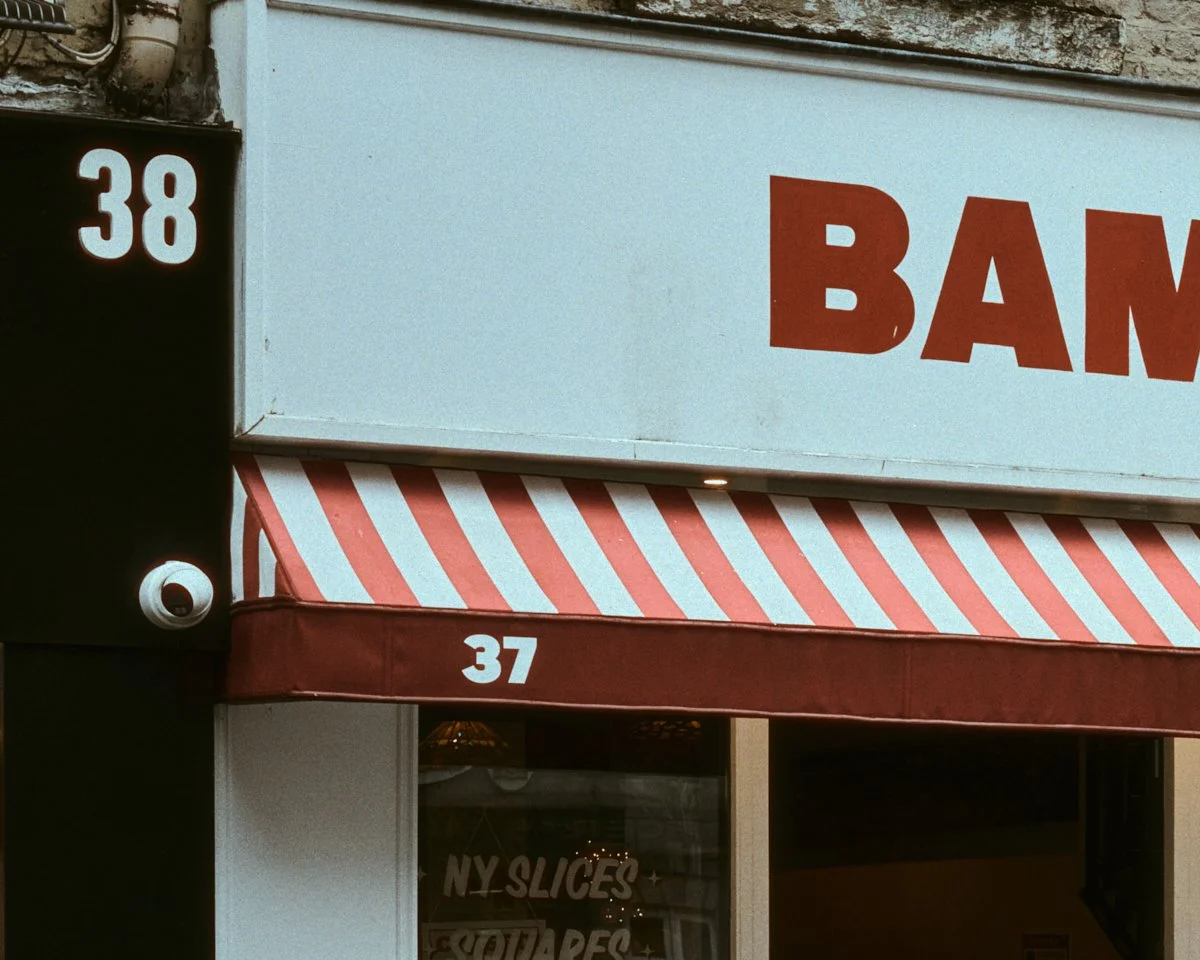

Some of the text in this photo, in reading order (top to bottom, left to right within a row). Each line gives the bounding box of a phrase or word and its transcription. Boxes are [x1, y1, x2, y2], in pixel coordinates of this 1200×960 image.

[78, 148, 197, 265] 38
[462, 634, 538, 685] 37
[443, 854, 639, 900] NY SLICES
